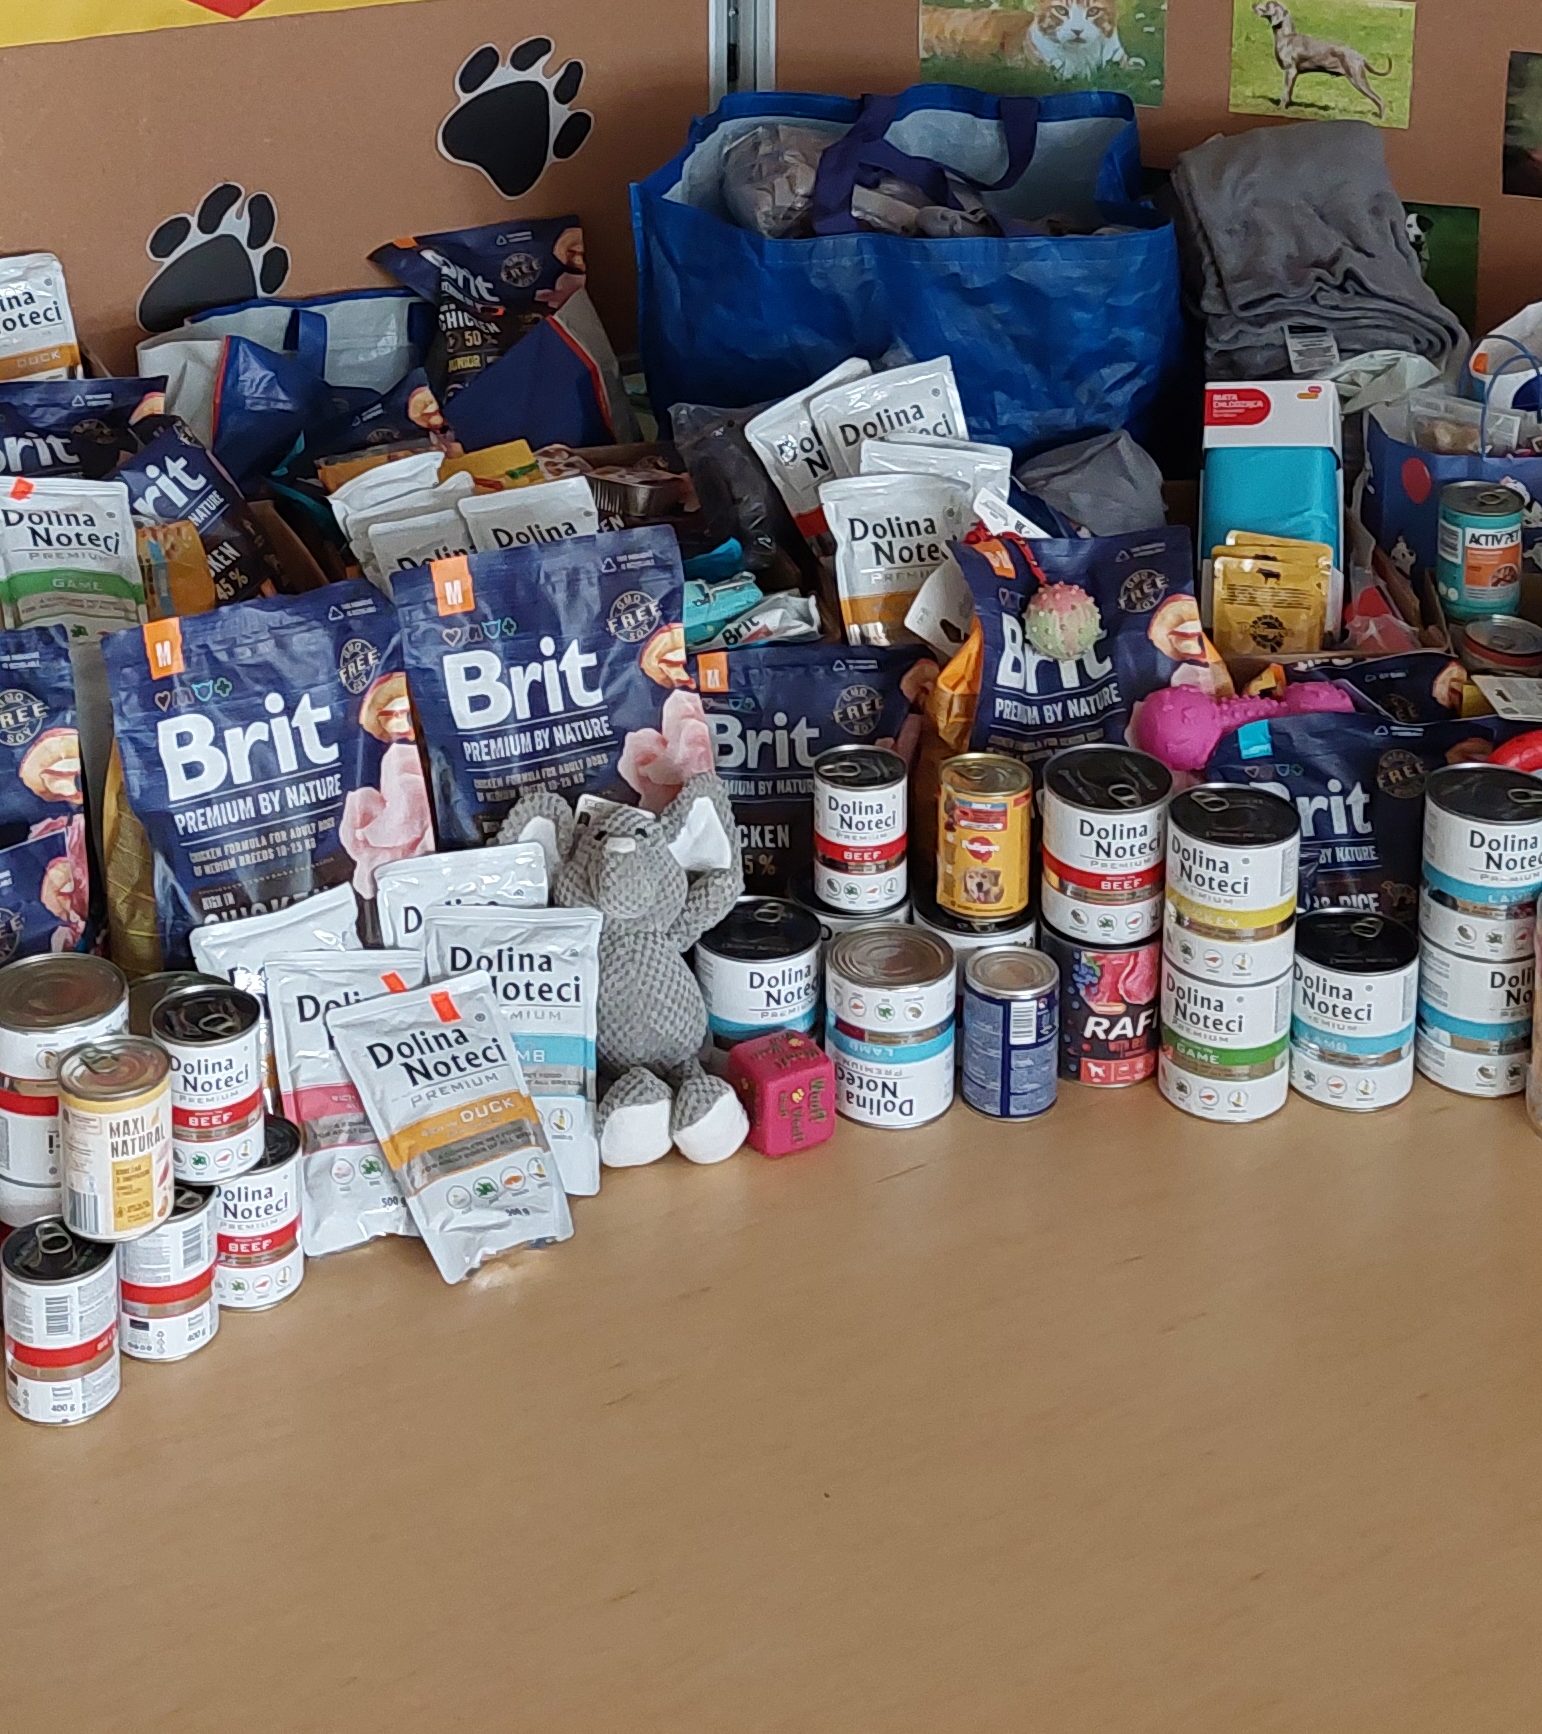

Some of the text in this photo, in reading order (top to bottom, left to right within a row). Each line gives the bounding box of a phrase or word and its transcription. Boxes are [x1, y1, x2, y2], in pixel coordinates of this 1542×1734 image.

[439, 310, 501, 334] CHICKEN
[464, 330, 483, 347] 50
[17, 349, 61, 368] DUCK
[839, 404, 925, 447] Dolina
[3, 507, 96, 530] Dolina
[188, 490, 225, 527] NATURE
[849, 514, 937, 541] Dolina
[29, 527, 121, 556] Noteci
[52, 577, 104, 592] GAME
[216, 577, 236, 601] 45
[446, 579, 463, 606] M
[608, 600, 660, 634] FREE
[156, 641, 173, 668] M
[442, 636, 604, 730] Brit
[1043, 683, 1123, 722] BY NATURE
[6, 728, 33, 744] SOY
[157, 693, 340, 801] Brit
[463, 715, 614, 762] PREMIUM BY NATURE
[706, 712, 820, 770] Brit
[758, 782, 773, 797] BY
[174, 775, 342, 837] PREMIUM BY NATURE
[828, 796, 885, 815] Dolina
[839, 811, 896, 833] Noteci
[1079, 819, 1148, 841] Dolina
[1172, 833, 1230, 875] Dolina
[1335, 844, 1377, 863] NATURE
[1469, 829, 1539, 852] Dolina
[843, 849, 883, 863] BEEF
[1101, 877, 1143, 891] BEEF
[1179, 860, 1250, 897] Noteci
[450, 946, 553, 974] Dolina
[749, 964, 812, 990] Dolina
[1165, 969, 1224, 1013] Dolina
[1174, 1000, 1244, 1036] Noteci
[1302, 988, 1373, 1023] Noteci
[366, 1028, 471, 1071] Dolina
[399, 1037, 508, 1088] Noteci
[1176, 1043, 1221, 1065] GAME
[183, 1068, 249, 1093] Noteci
[410, 1072, 500, 1110] PREMIUM
[459, 1097, 516, 1124] DUCK
[845, 1089, 914, 1117] Dolina
[109, 1116, 146, 1140] MAXI
[188, 1111, 234, 1126] BEEF
[111, 1124, 166, 1159] NATURAL
[223, 1192, 289, 1220] Noteci
[381, 1197, 399, 1208] 500
[228, 1239, 272, 1253] BEEF
